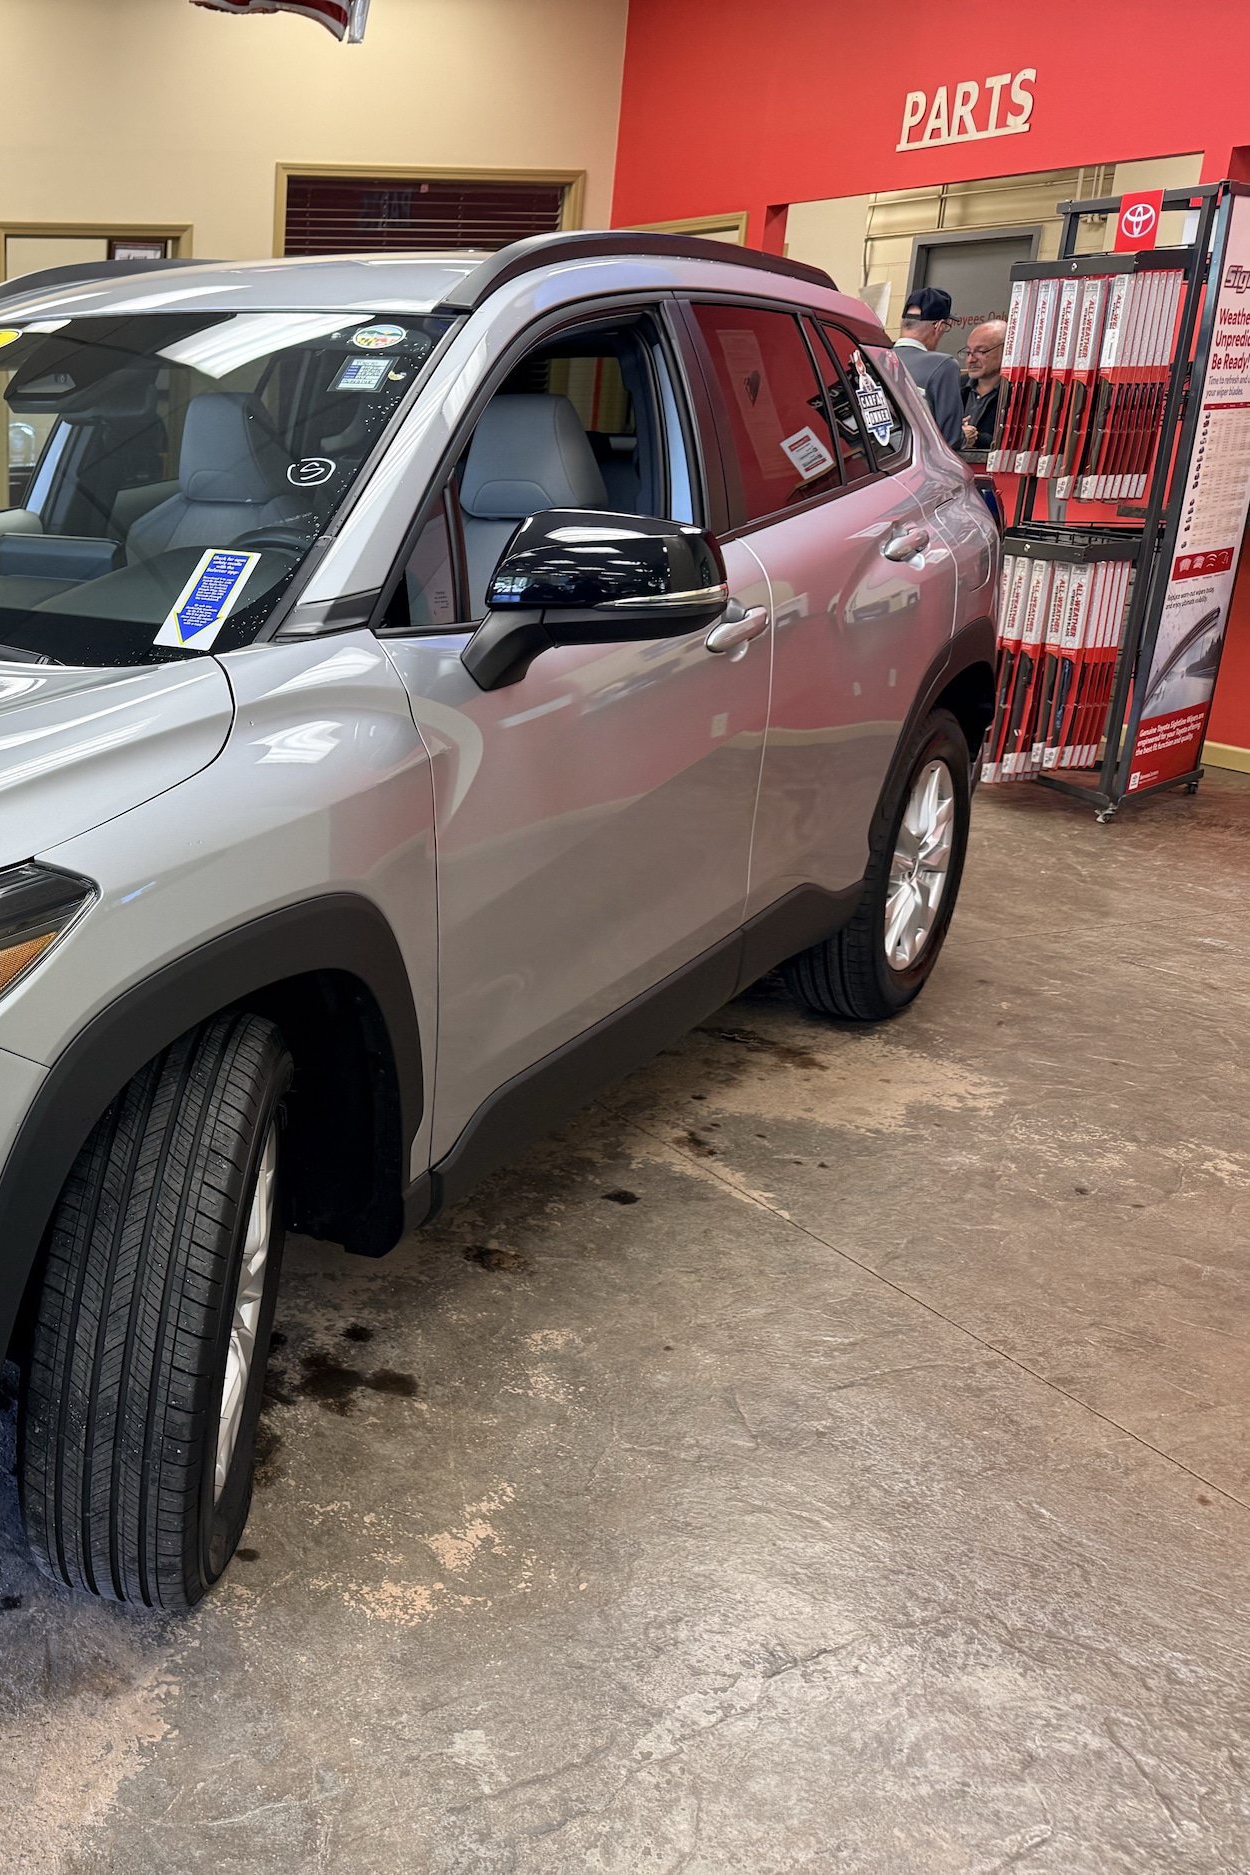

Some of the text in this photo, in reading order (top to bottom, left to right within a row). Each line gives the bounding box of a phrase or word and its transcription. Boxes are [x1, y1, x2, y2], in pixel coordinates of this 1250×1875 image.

[898, 68, 1037, 146] PARTS
[1034, 300, 1047, 357] ALL-WEATHER
[1059, 300, 1072, 358] ALL-WEATHER
[1081, 300, 1095, 358] ALL-WEATHER
[1211, 353, 1222, 370] Be
[1010, 576, 1022, 628] ALL-WEATHER
[1028, 579, 1040, 632] ALL-WEATHER
[1054, 579, 1066, 633] ALL-WEATHER
[1070, 582, 1083, 637] ALL-WEATHER
[1135, 748, 1143, 757] the
[1143, 745, 1153, 755] best
[1137, 733, 1160, 748] engineered
[1166, 730, 1175, 740] your
[1176, 726, 1188, 737] Toyota
[1139, 727, 1157, 738] Genuine
[1157, 723, 1170, 734] Toyota
